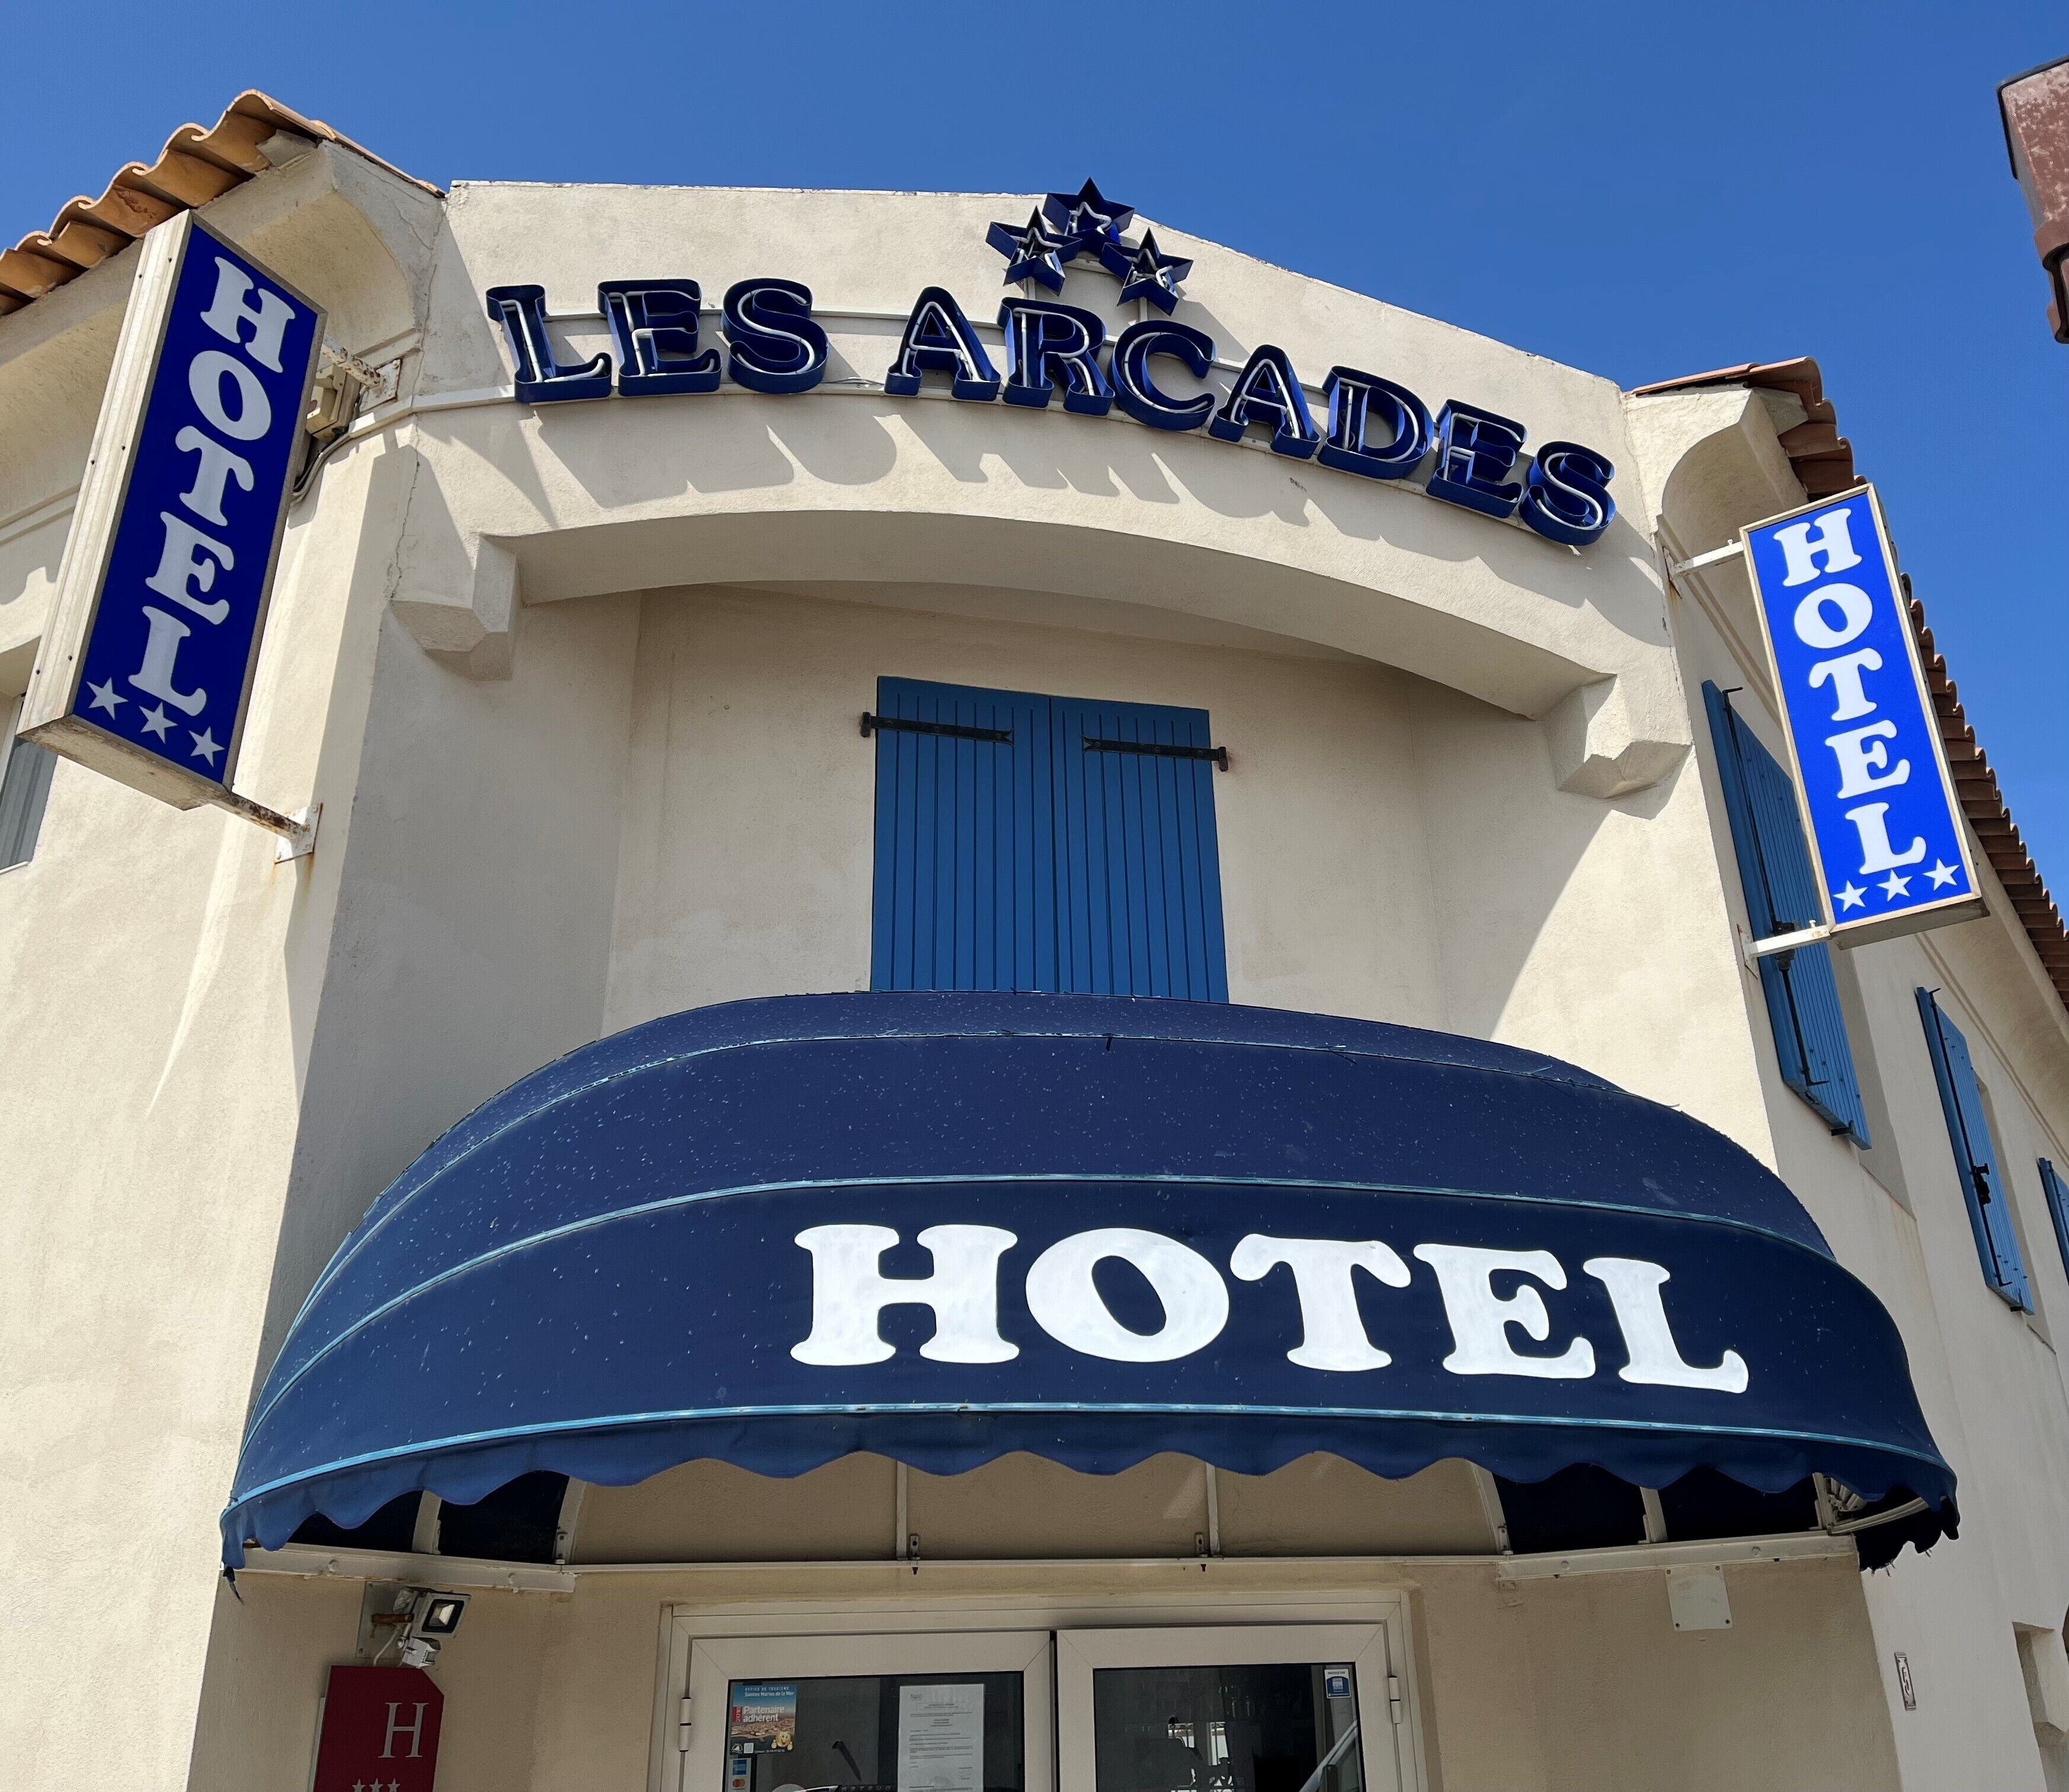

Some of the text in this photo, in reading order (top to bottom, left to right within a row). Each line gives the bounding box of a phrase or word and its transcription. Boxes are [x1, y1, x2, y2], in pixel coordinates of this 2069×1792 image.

[127, 257, 296, 716] HOTEL
[486, 278, 1616, 546] LES ARCADES
[1773, 508, 1927, 875] HOTEL
[789, 1224, 1750, 1393] HOTEL
[377, 1702, 429, 1758] H
[742, 1713, 779, 1723] adhérent
[743, 1705, 785, 1714] Partenaire
